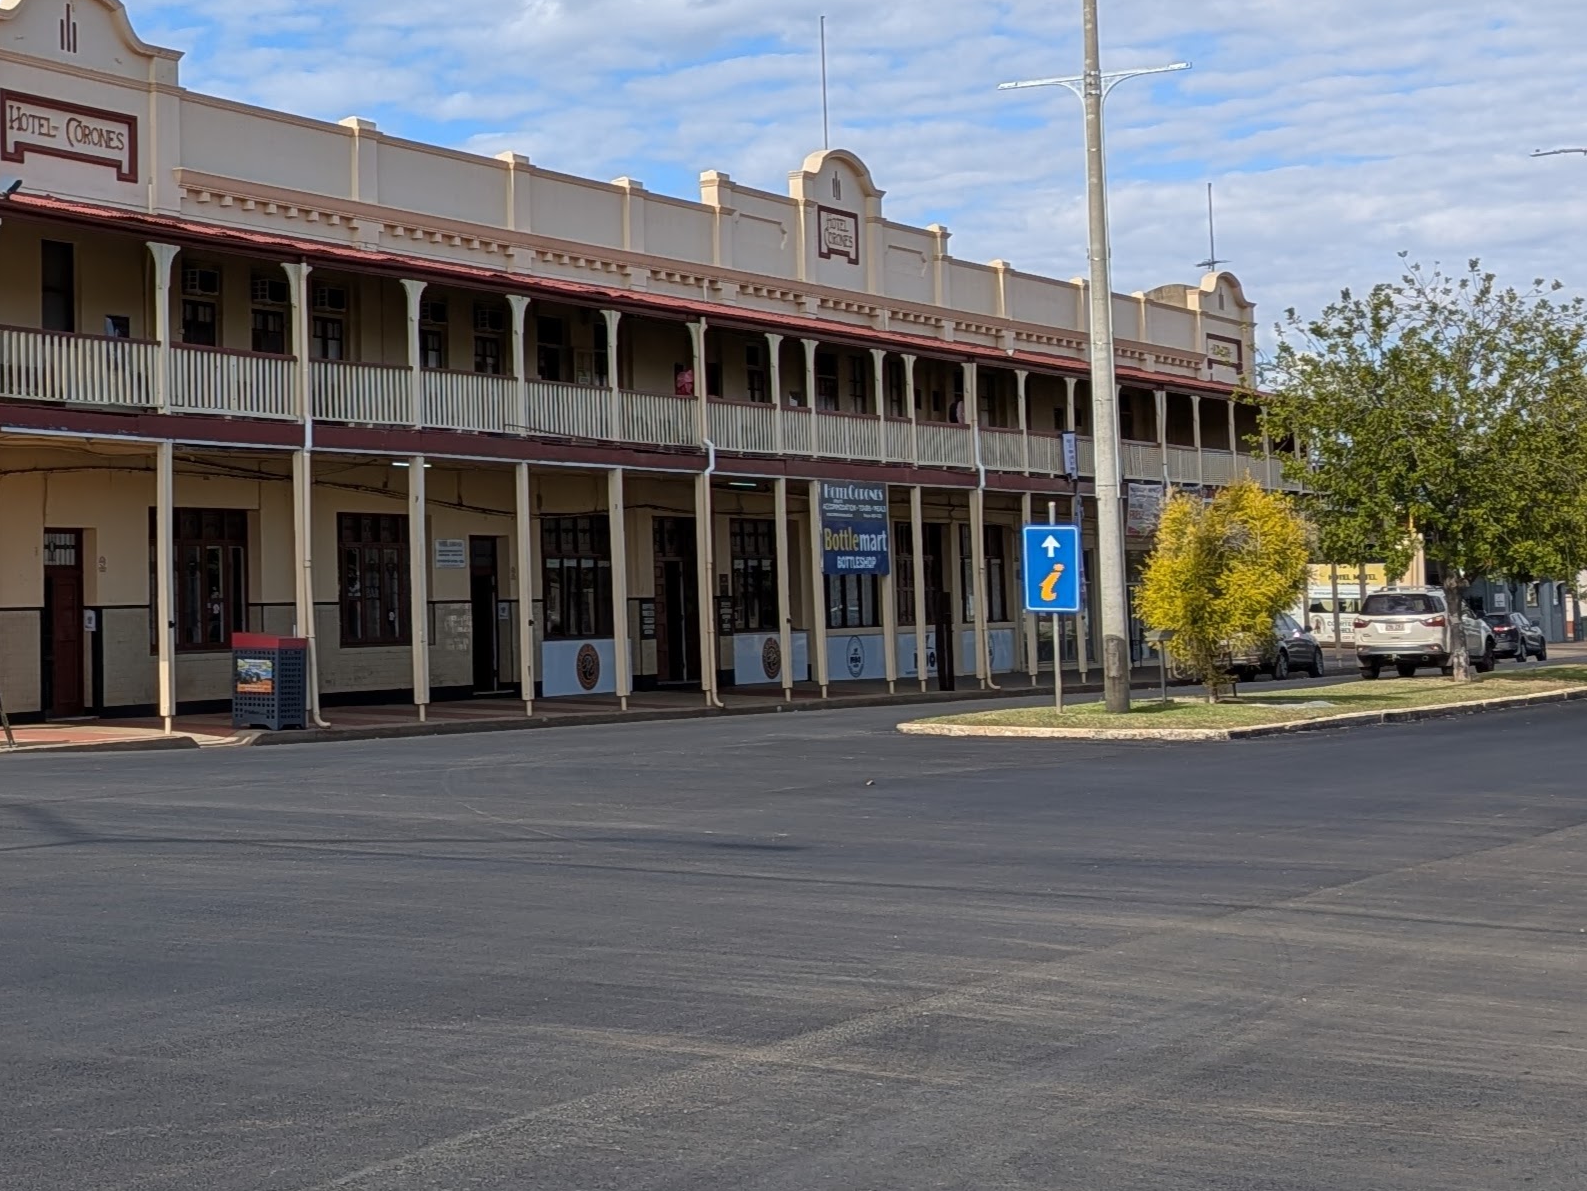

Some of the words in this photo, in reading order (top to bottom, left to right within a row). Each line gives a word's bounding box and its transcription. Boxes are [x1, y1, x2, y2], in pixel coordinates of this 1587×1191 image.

[66, 117, 125, 151] CORONES
[824, 526, 887, 552] Bottlemart
[836, 555, 877, 569] BOTTLESHOP
[1328, 573, 1352, 581] HTEL
[1353, 573, 1378, 581] MTEL
